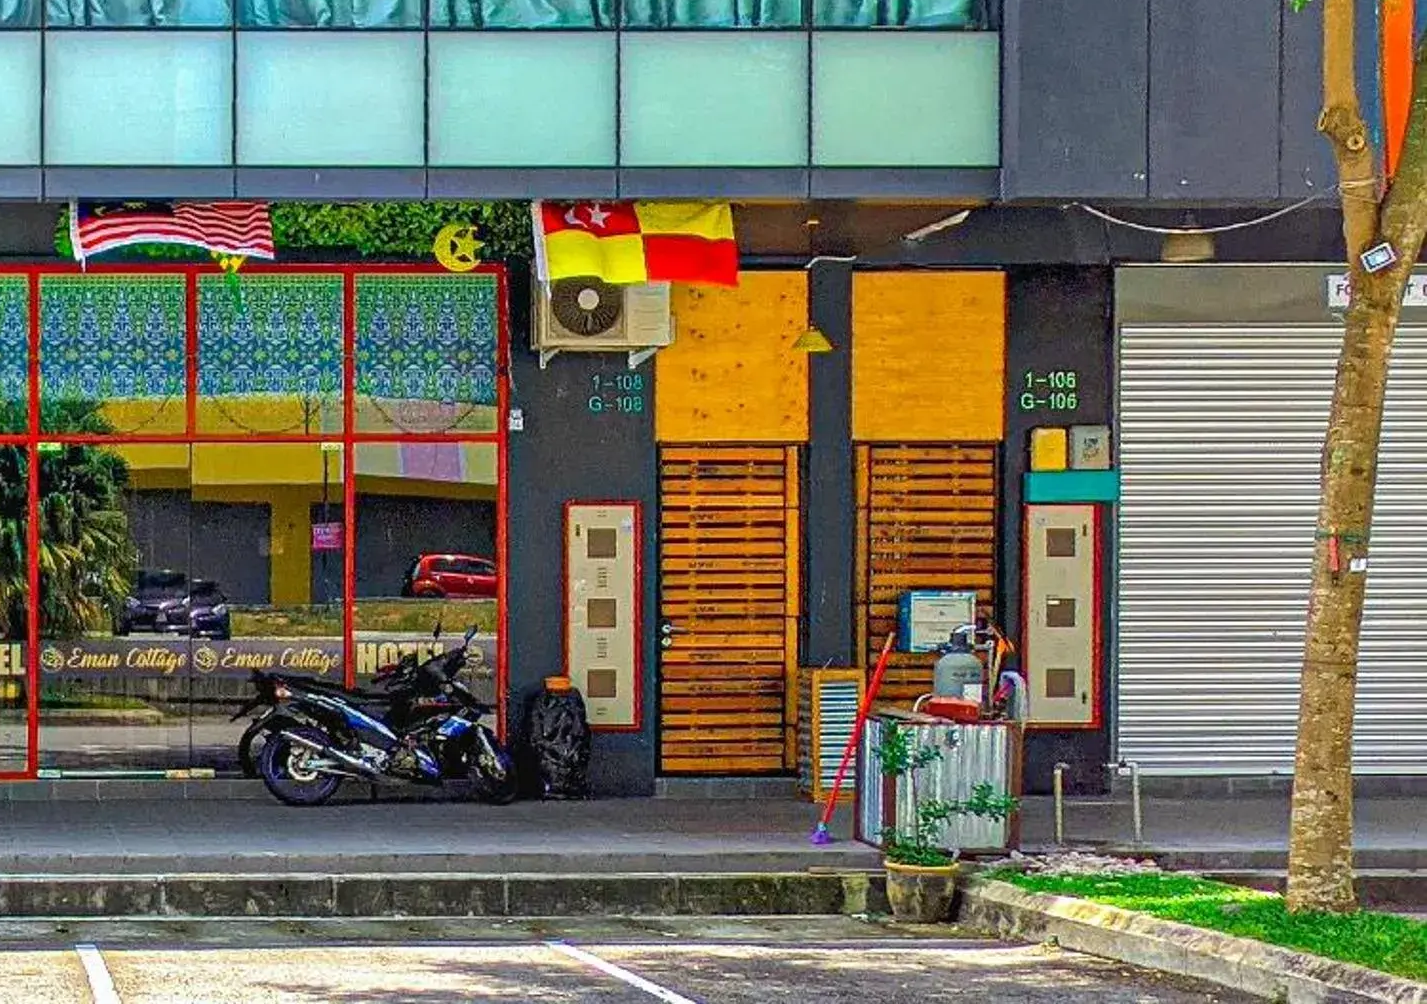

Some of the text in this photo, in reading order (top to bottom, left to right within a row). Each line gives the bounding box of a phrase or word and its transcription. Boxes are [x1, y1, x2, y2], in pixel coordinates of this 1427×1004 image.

[592, 374, 644, 391] 1-108
[1025, 371, 1077, 388] 1-106
[1020, 392, 1078, 409] G-106
[67, 647, 186, 674] Eman Cottage
[221, 647, 340, 674] Eman Cottage
